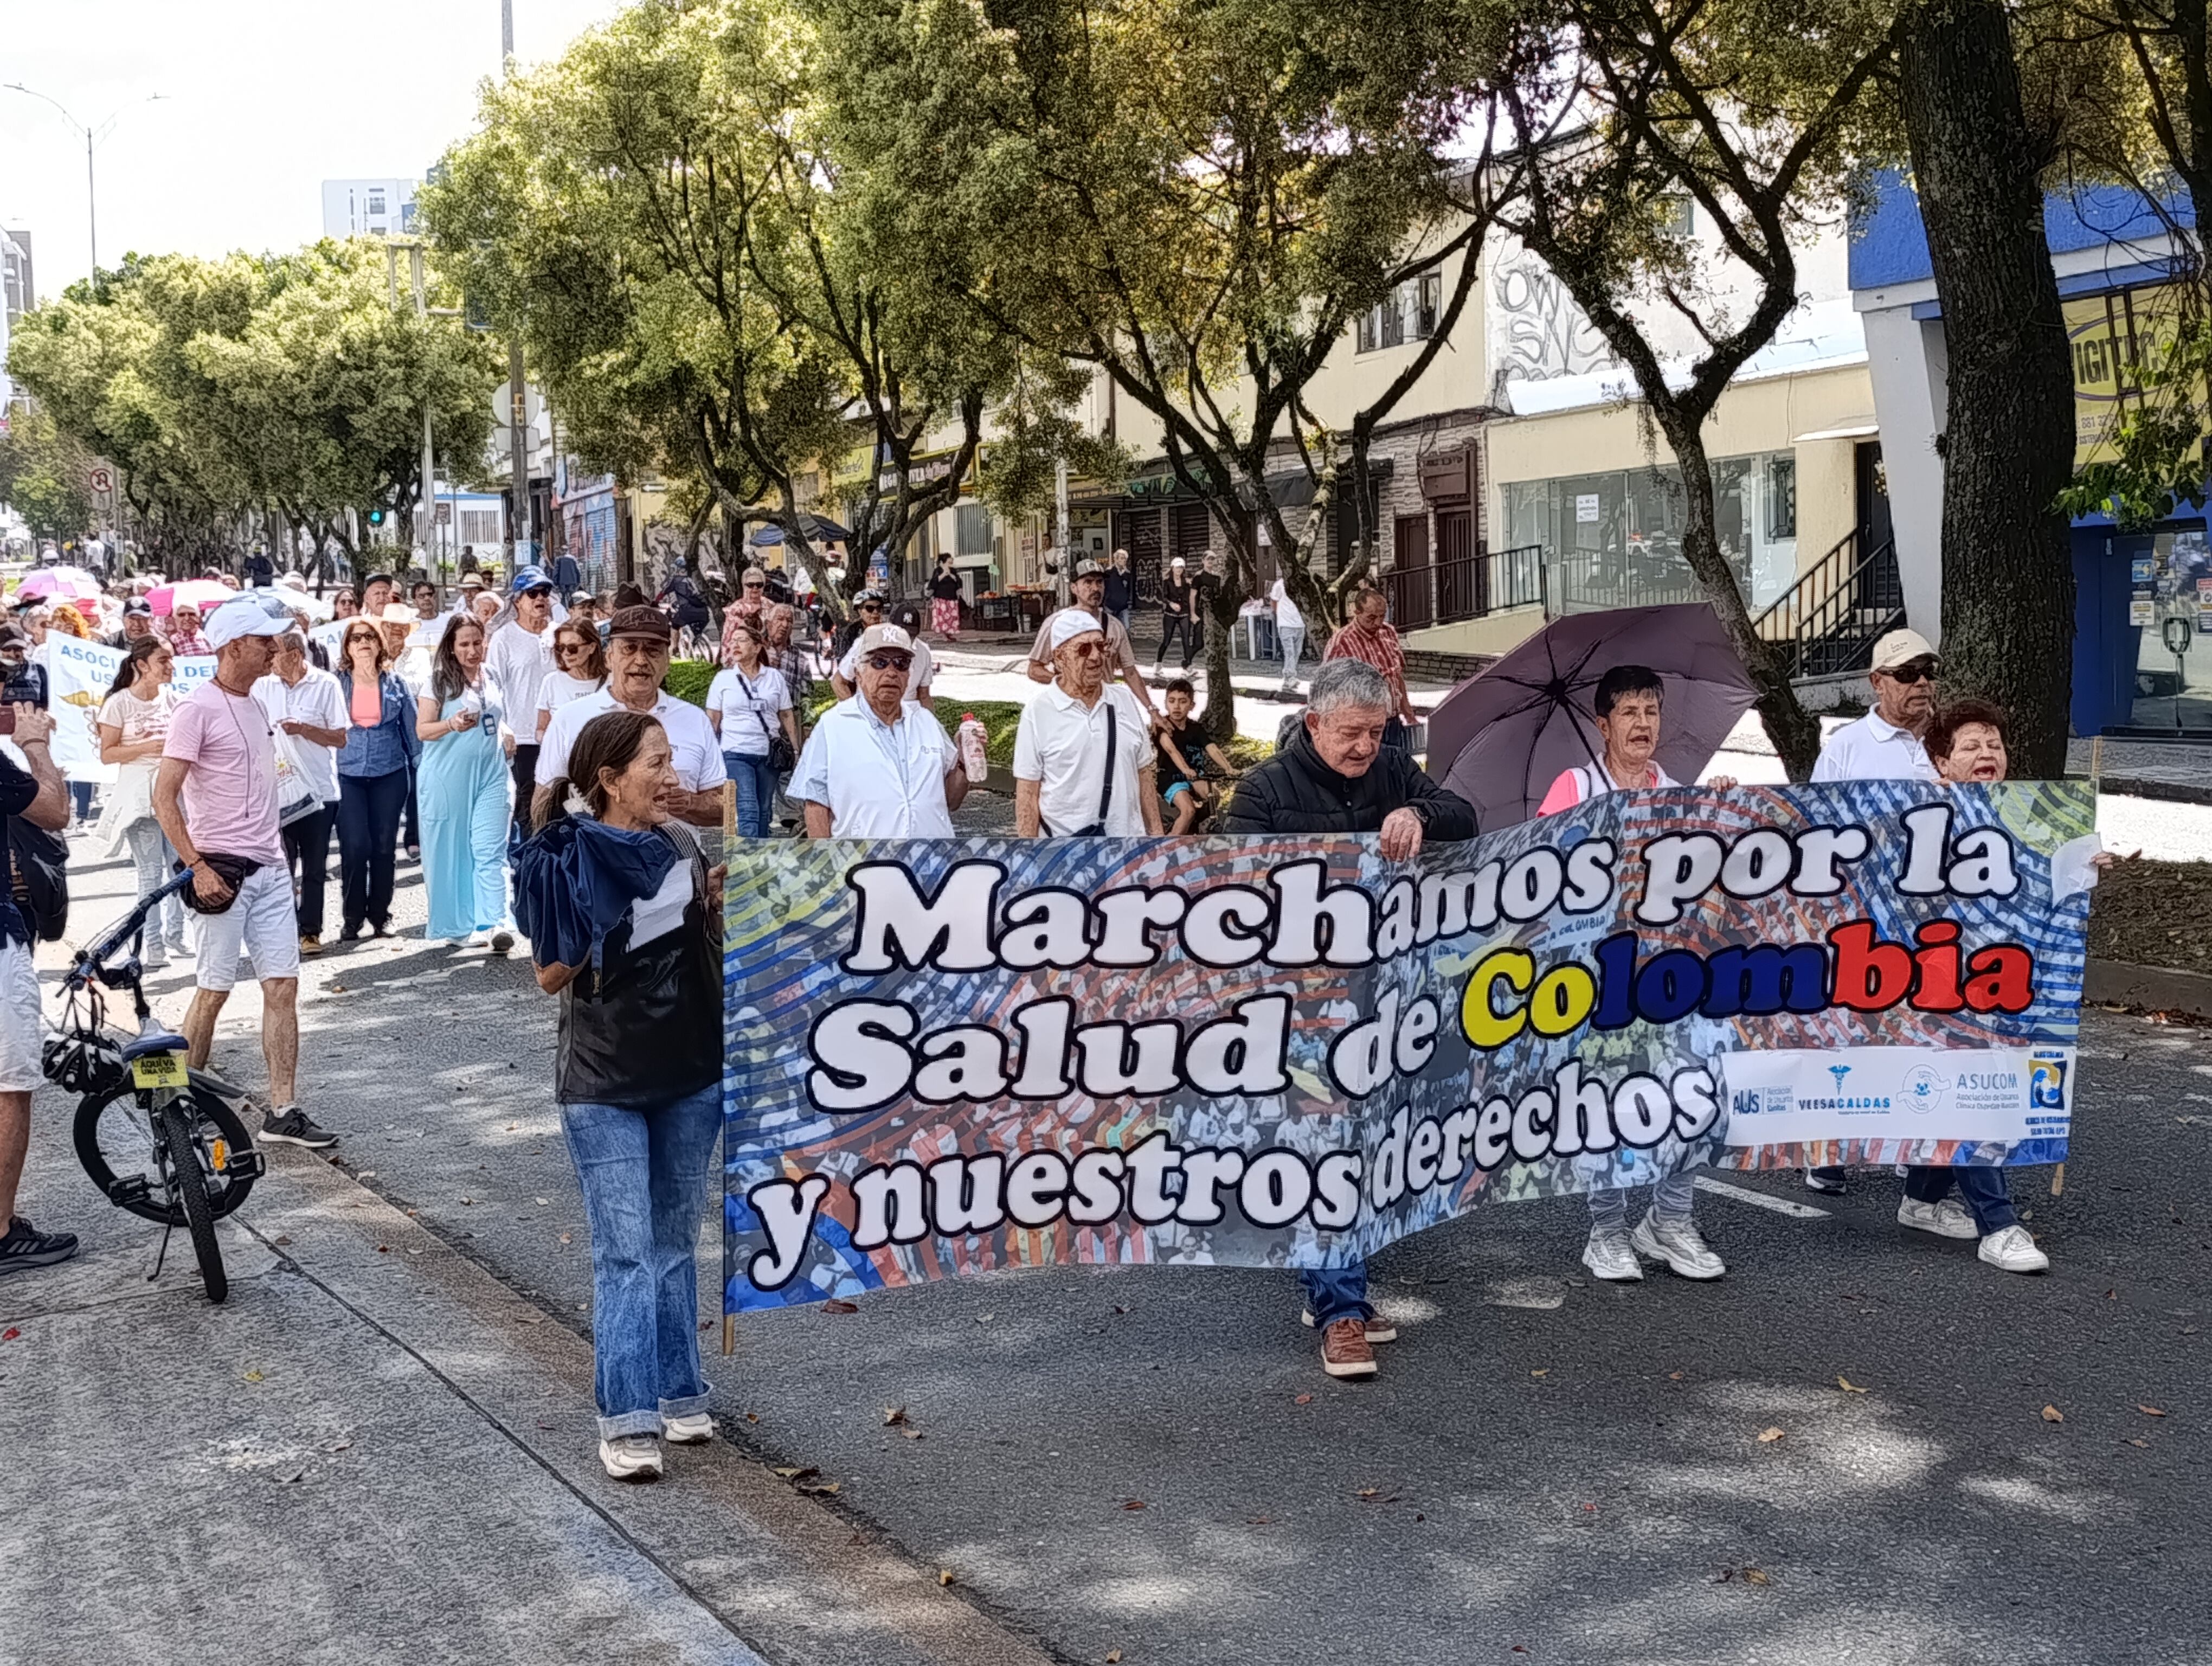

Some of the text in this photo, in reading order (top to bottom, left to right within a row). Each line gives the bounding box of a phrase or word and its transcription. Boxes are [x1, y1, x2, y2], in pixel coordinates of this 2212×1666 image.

[61, 644, 115, 669] ASOCI
[838, 802, 2022, 976] Marchamos por la
[805, 918, 2035, 1114] Salud de Colombia
[1733, 1088, 1759, 1115] AUS
[1957, 1073, 2018, 1090] ASUCOM
[747, 1056, 1720, 1291] y nuestros derechos
